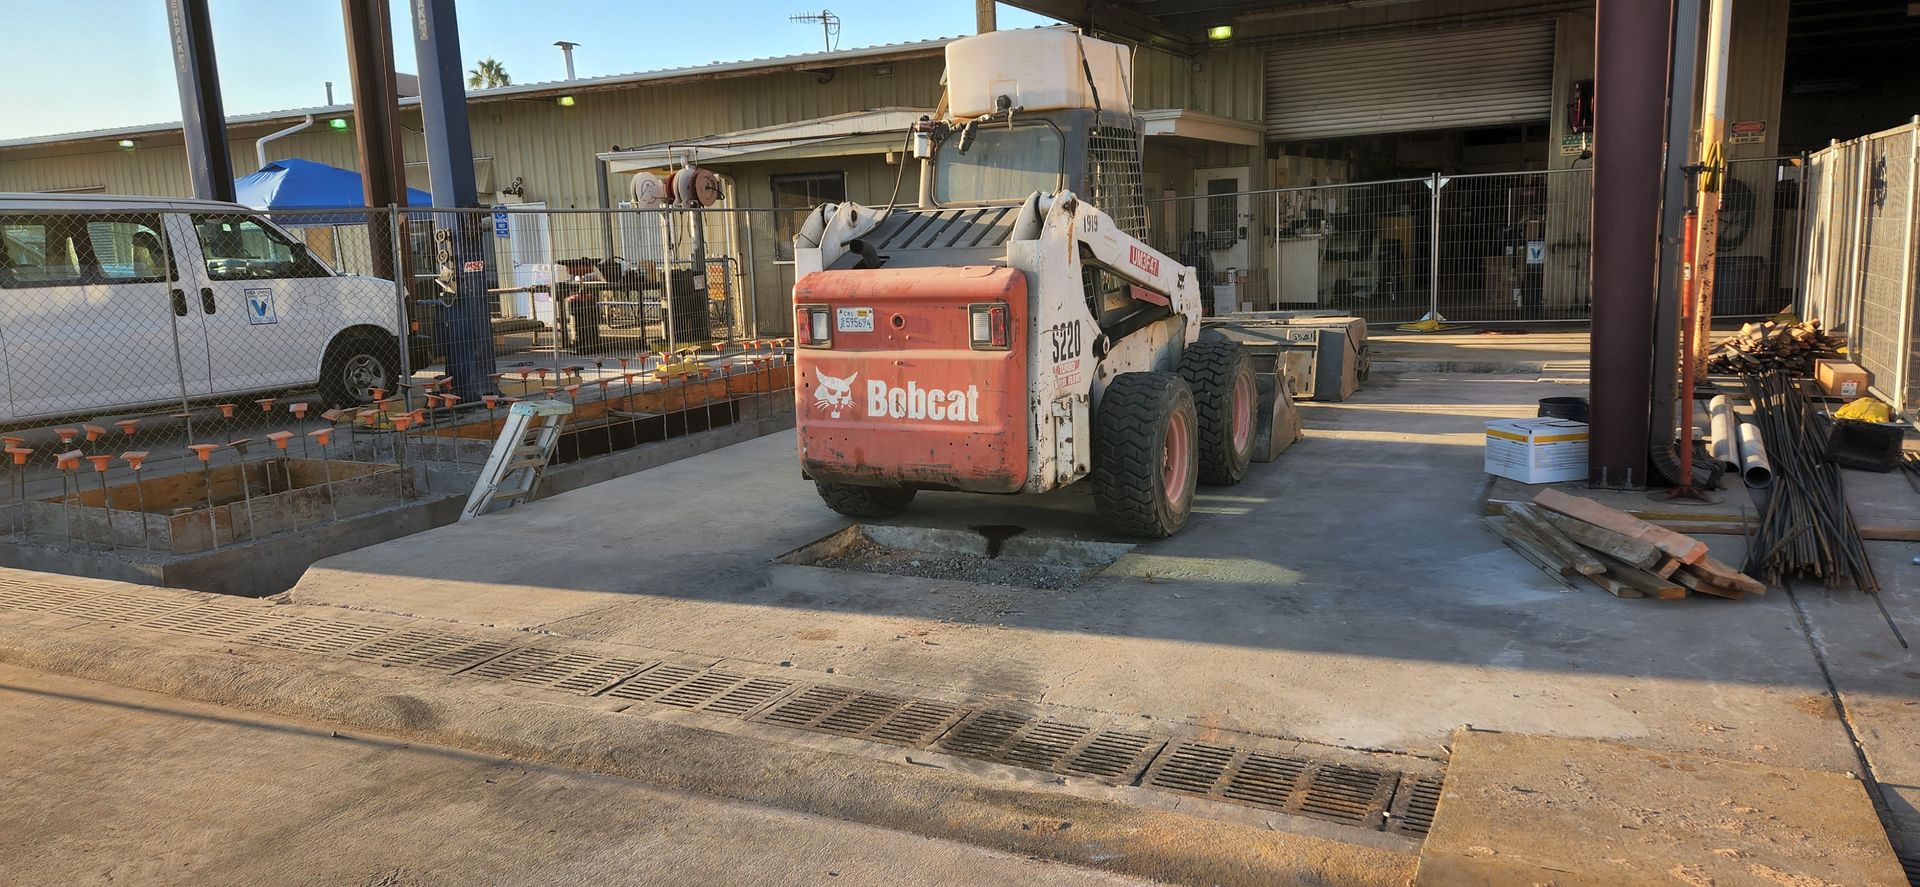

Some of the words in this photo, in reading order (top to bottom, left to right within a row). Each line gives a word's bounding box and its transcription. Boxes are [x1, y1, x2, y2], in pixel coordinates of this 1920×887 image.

[1083, 215, 1099, 233] 1919
[1132, 247, 1158, 275] UM3F47
[1052, 319, 1081, 364] S220
[867, 379, 979, 422] Bobcat
